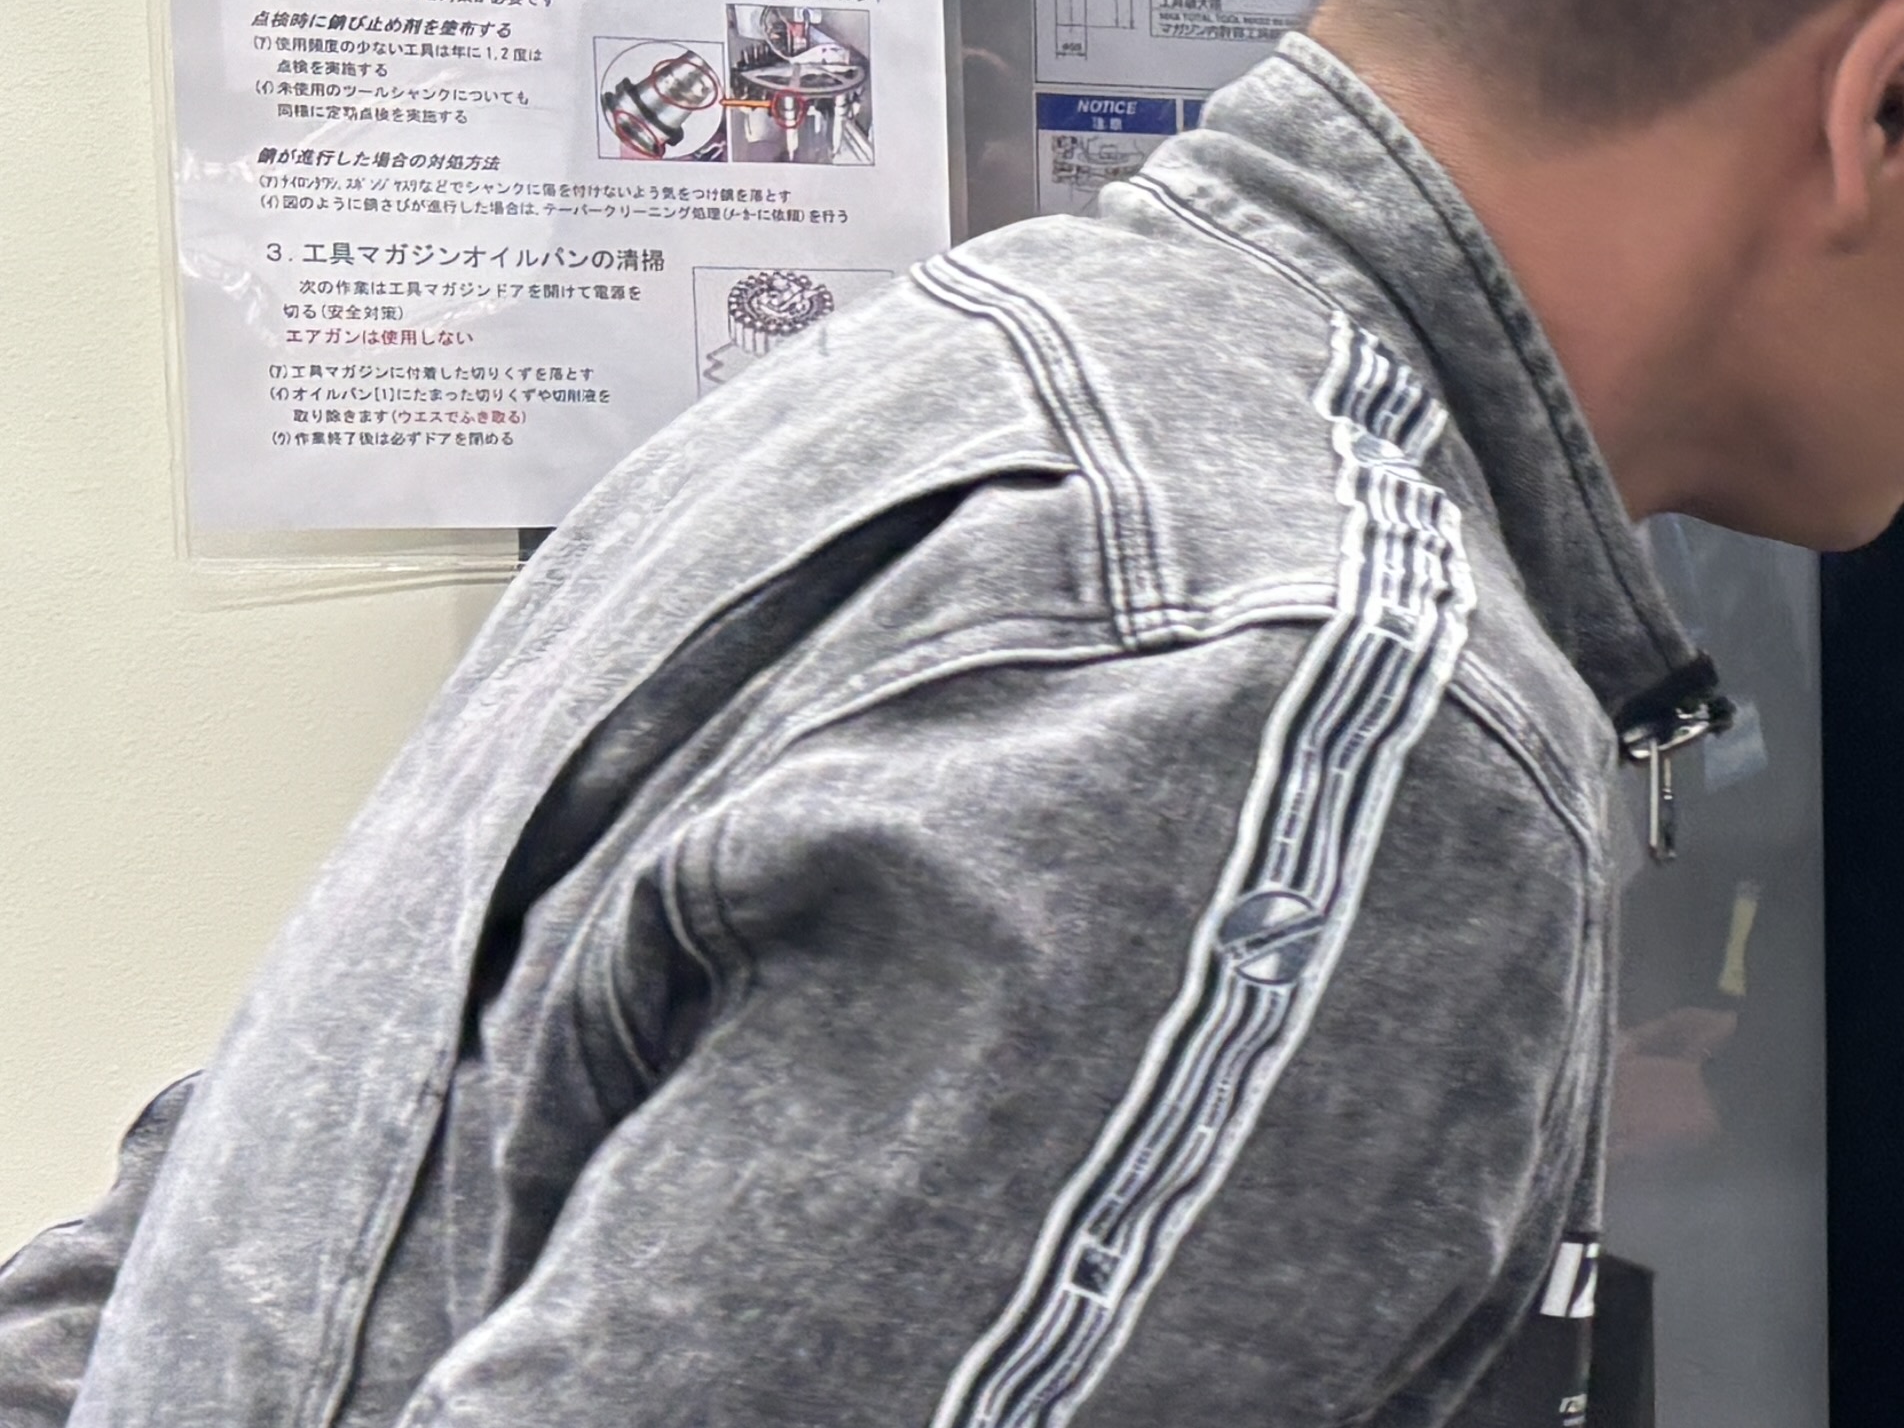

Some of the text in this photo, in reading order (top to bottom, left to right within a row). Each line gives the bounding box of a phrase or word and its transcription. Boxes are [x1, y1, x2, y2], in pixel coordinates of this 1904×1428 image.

[1077, 98, 1138, 116] NOTICE
[284, 327, 475, 348] エアガンは使用しない
